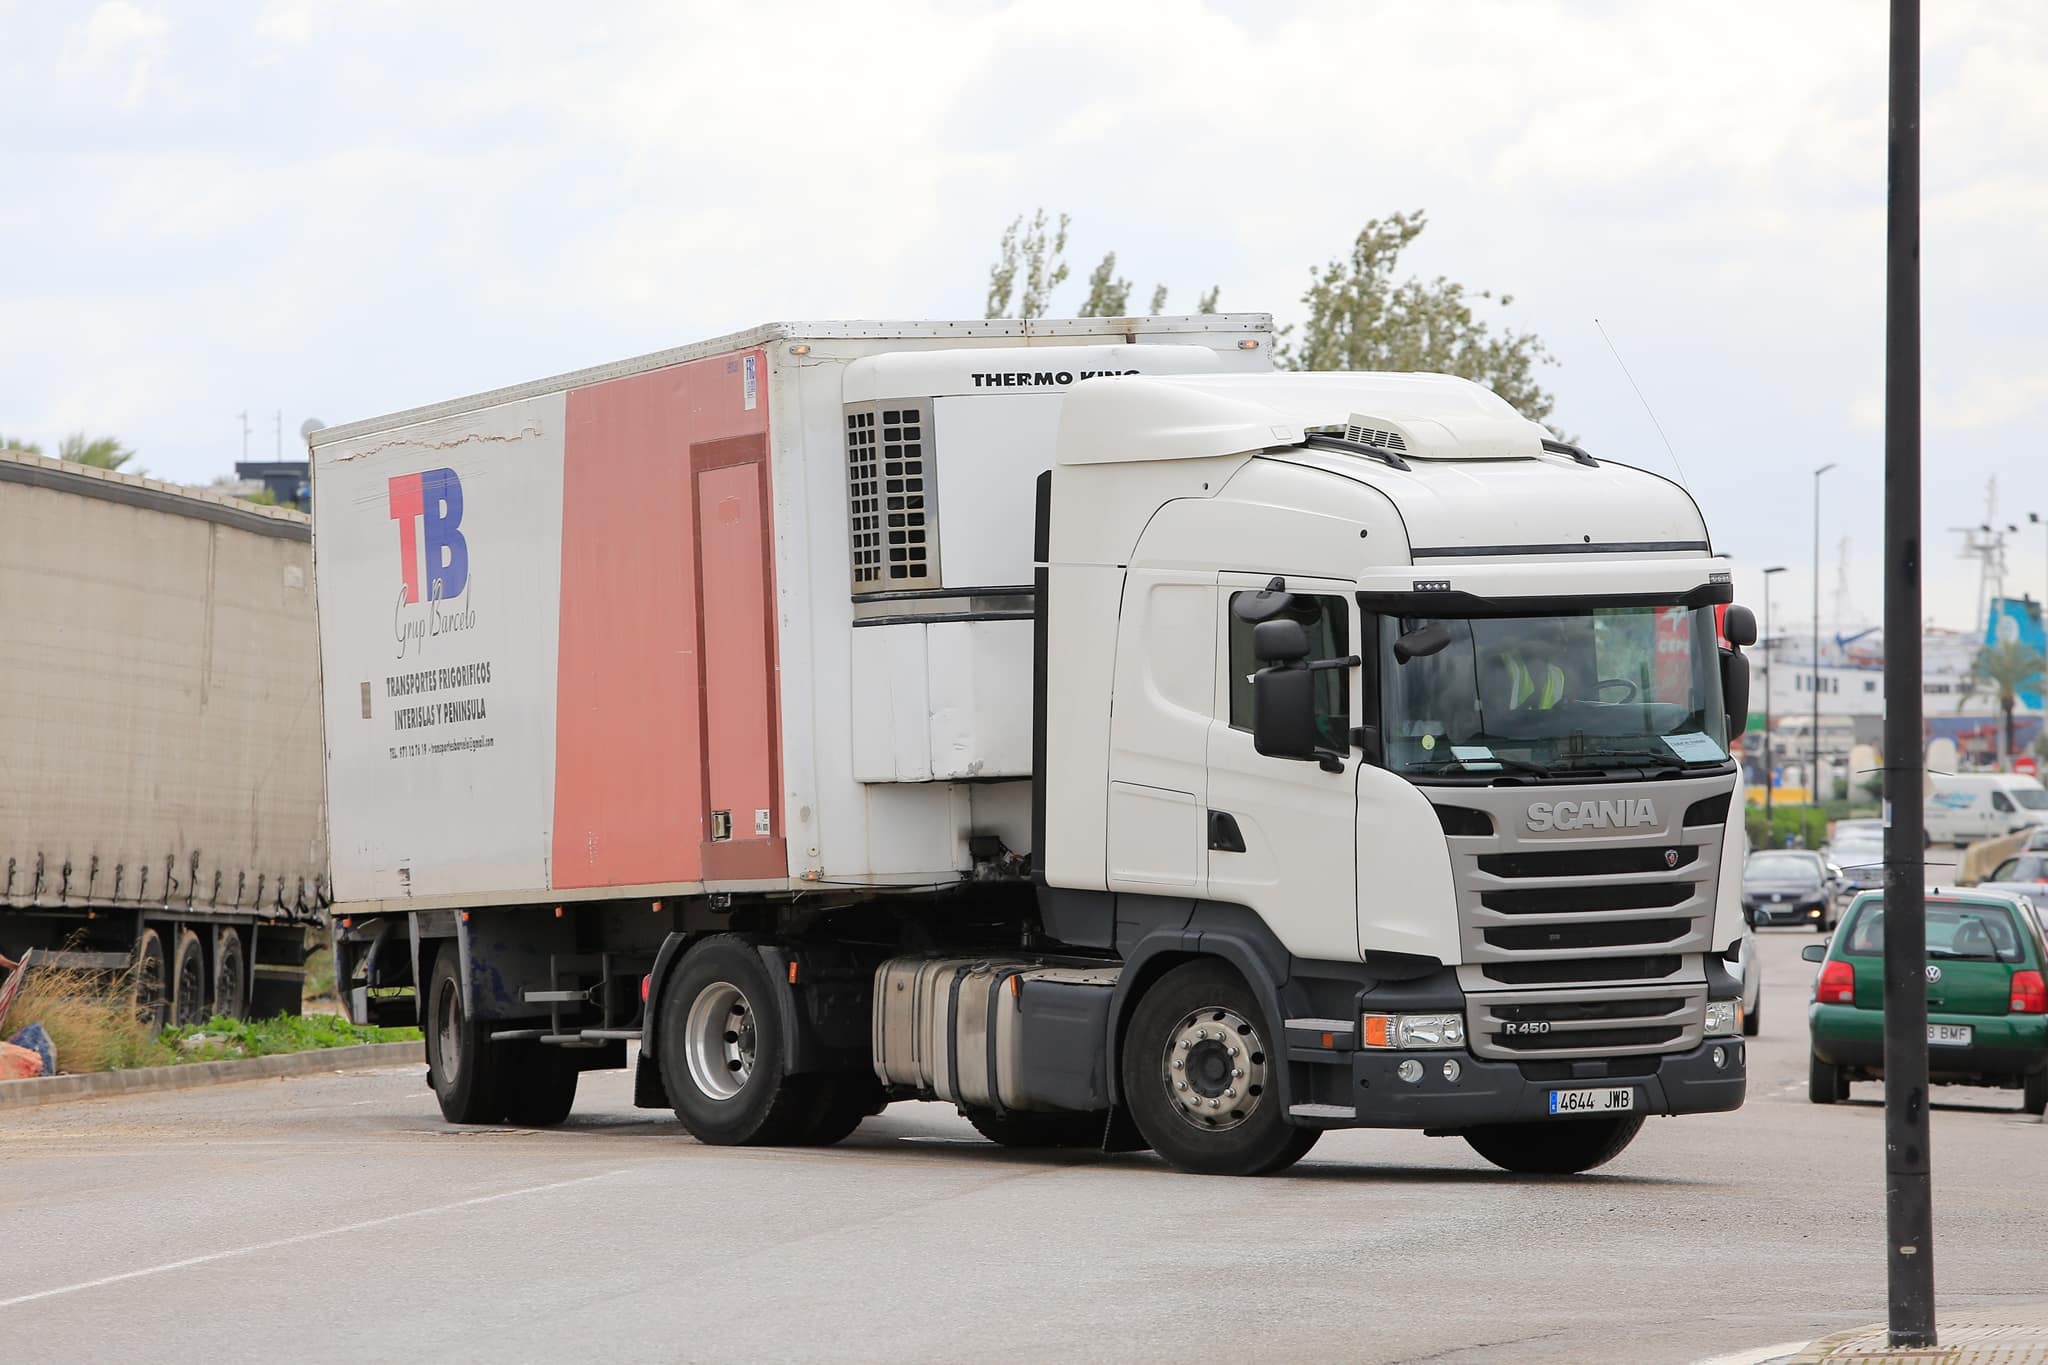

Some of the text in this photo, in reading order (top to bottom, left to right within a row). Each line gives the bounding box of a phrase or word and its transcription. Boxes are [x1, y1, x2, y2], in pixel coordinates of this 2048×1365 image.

[972, 372, 1073, 387] THERMO
[388, 467, 468, 604] TB
[386, 661, 491, 697] TRANSPORTES FRIGORIFICOS
[394, 697, 486, 730] INTERISLAS Y PENINSULA
[1526, 798, 1658, 832] SCANIA
[1506, 1022, 1550, 1035] R 450
[1940, 1026, 1967, 1040] BMF
[1560, 1092, 1594, 1111] 4644
[1604, 1090, 1630, 1109] JWB
